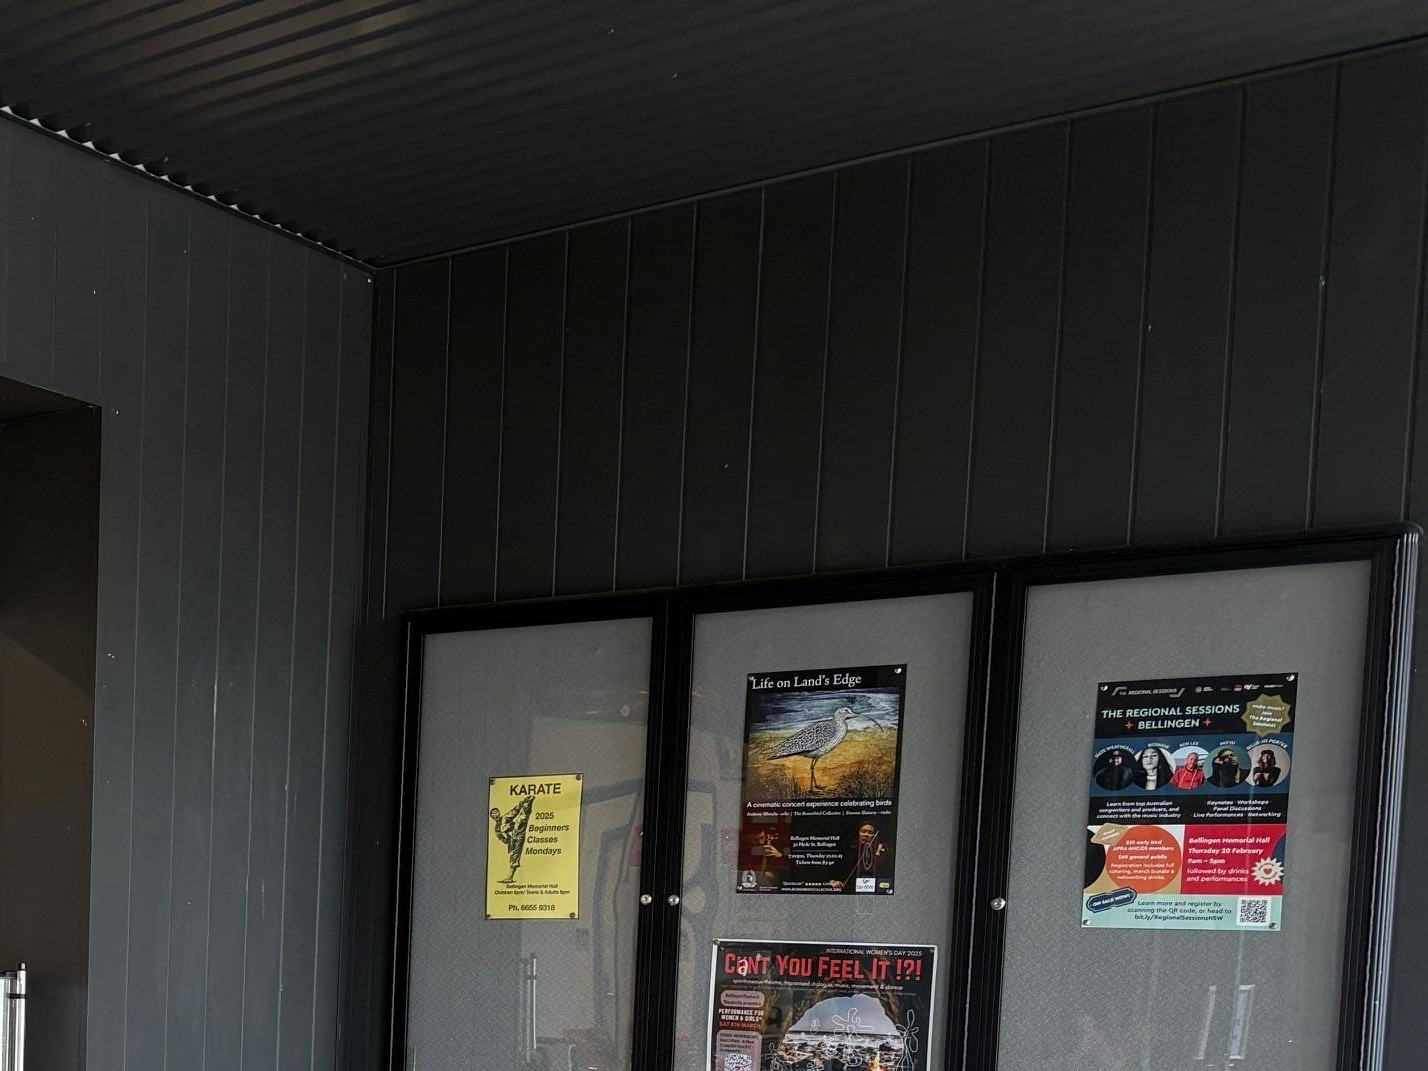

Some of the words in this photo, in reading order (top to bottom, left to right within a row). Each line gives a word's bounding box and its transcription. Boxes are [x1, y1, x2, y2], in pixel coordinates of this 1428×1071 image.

[751, 678, 774, 690] Life
[777, 680, 791, 688] on
[794, 674, 830, 688] Land's
[833, 673, 862, 687] Edge
[1101, 709, 1124, 719] THE
[1125, 707, 1183, 718] REGIONAL
[1185, 704, 1240, 715] SESSIONS
[1137, 718, 1200, 730] BELLINGEN
[510, 783, 562, 796] KARATE
[806, 801, 839, 809] experience
[840, 800, 875, 808] celebrating
[875, 799, 892, 807] birds
[535, 812, 555, 820] 2025
[528, 824, 570, 834] Beginners
[526, 836, 559, 844] Classes
[1188, 837, 1221, 845] Bellingen
[525, 847, 562, 856] Mondays
[508, 904, 520, 912] Ph.
[826, 948, 865, 956] INTERNATIONAL
[718, 1008, 754, 1016] PERFORMANCE
